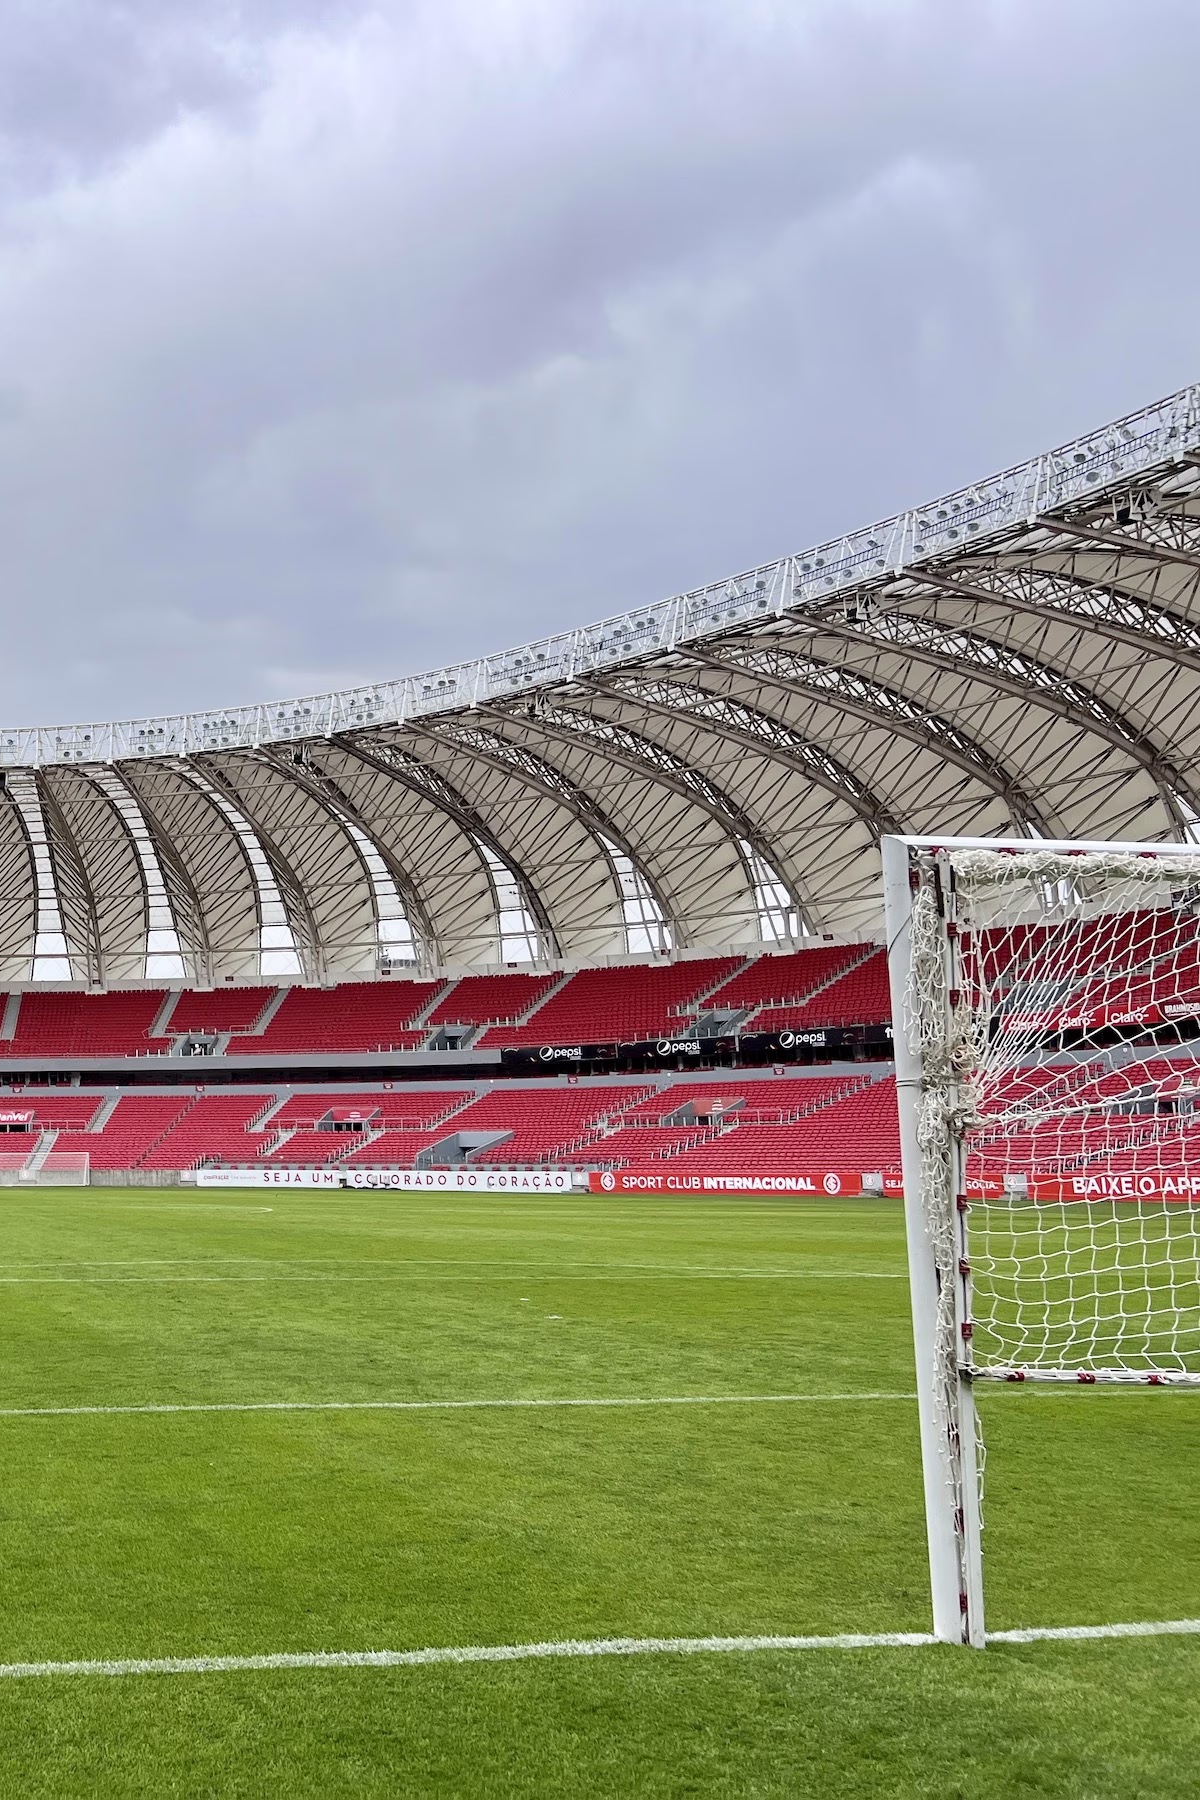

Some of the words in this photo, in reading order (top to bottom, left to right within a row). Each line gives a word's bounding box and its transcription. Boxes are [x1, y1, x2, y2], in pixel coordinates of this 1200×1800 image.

[1059, 1013, 1094, 1028] Claro
[1111, 1008, 1147, 1023] Claro
[796, 1031, 826, 1045] pepsi
[554, 1046, 582, 1058] pepsi
[672, 1040, 700, 1053] pepsi
[263, 1172, 302, 1183] SEJA
[312, 1173, 333, 1183] UM
[456, 1175, 477, 1186] DO
[487, 1173, 564, 1190] CORAÇÃO
[622, 1176, 663, 1189] SPORT
[667, 1176, 701, 1189] CLUB
[703, 1177, 816, 1190] INTERNACIONAL
[1072, 1176, 1131, 1194] BAIXE
[1139, 1176, 1155, 1195] O
